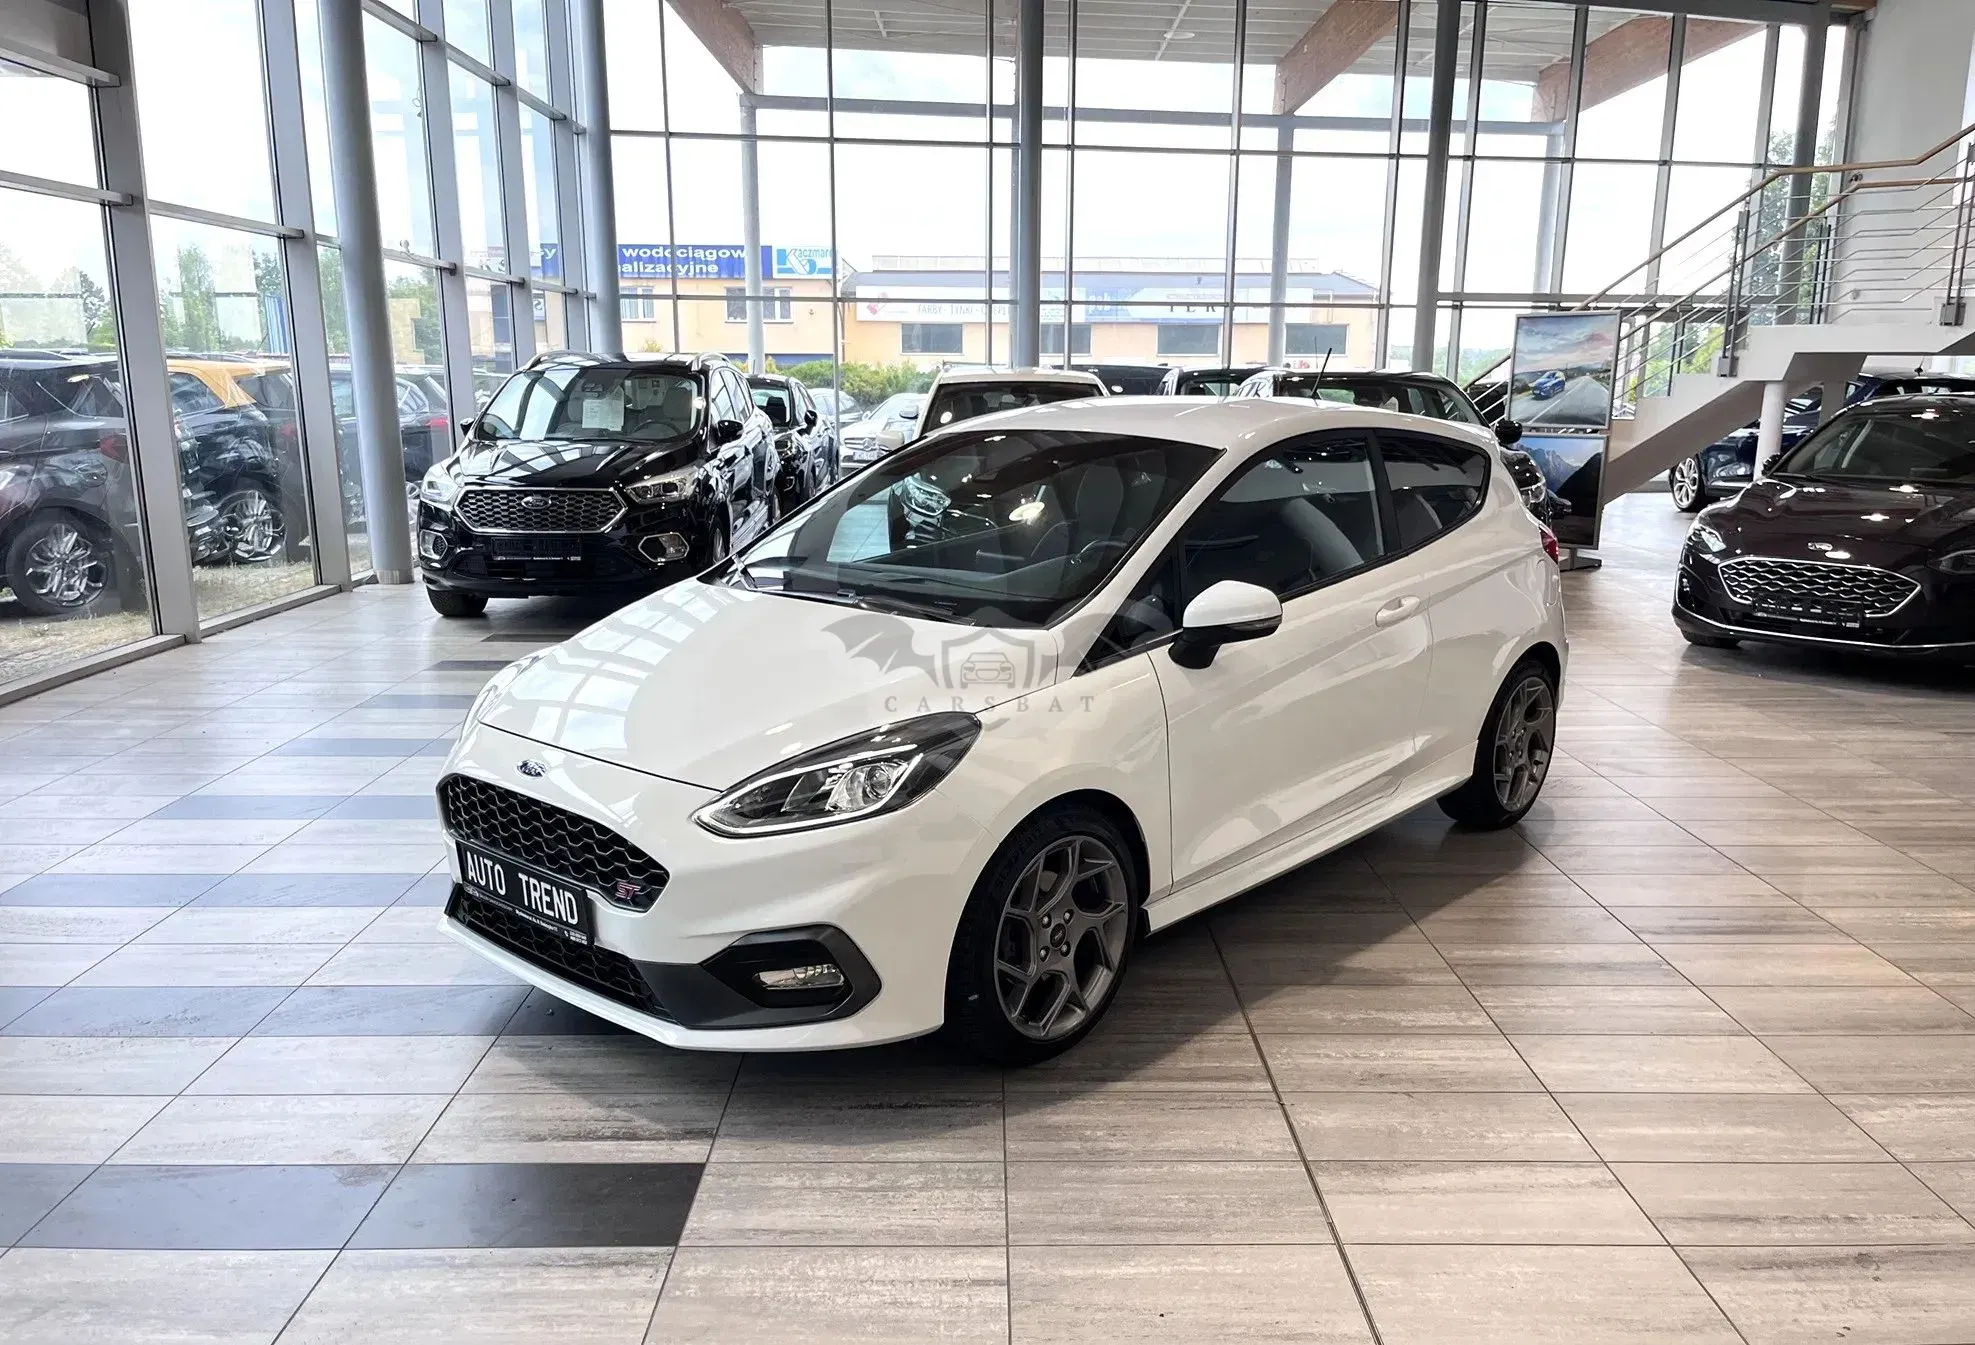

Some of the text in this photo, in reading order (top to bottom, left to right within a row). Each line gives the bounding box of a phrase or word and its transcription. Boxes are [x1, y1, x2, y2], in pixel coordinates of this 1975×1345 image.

[621, 246, 745, 261] wodociągow
[466, 850, 507, 896] AUTO
[518, 872, 579, 925] TREND
[614, 881, 642, 900] ST
